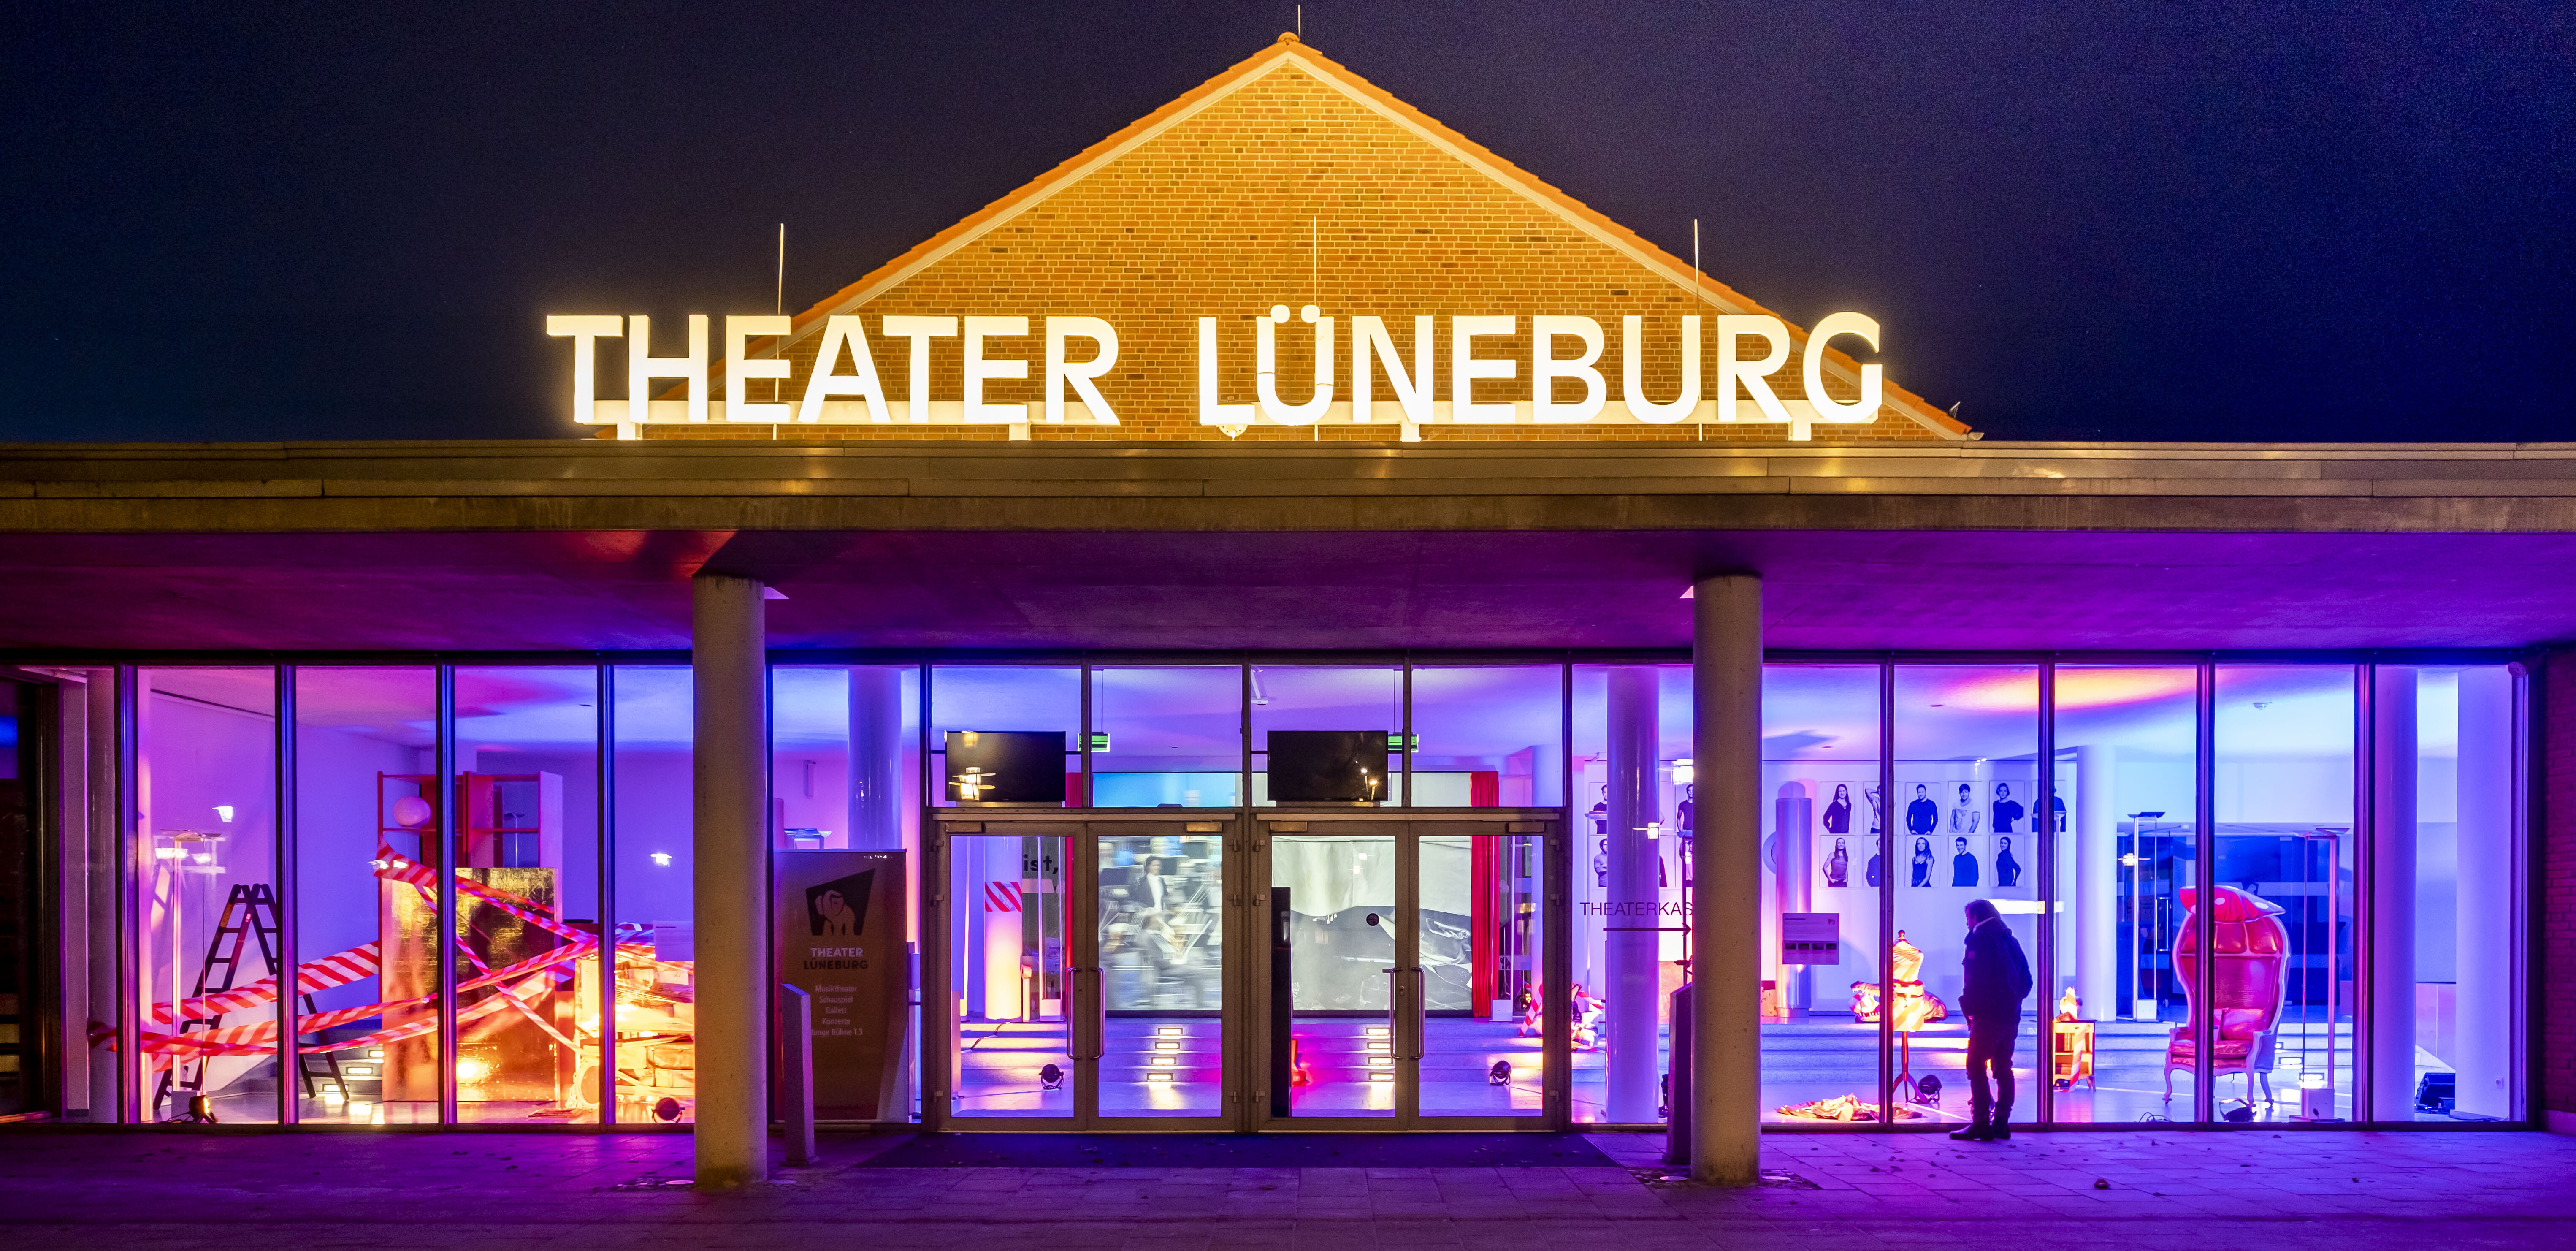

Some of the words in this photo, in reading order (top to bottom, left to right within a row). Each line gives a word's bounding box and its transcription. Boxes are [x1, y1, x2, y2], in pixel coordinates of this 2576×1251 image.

[546, 315, 1121, 426] THEATER
[1198, 304, 1883, 424] LÜNEBURG
[1023, 854, 1059, 874] ist,
[810, 947, 863, 957] THEATER
[804, 958, 868, 970] LÜNEBURG
[819, 996, 853, 1005] Schauspiel
